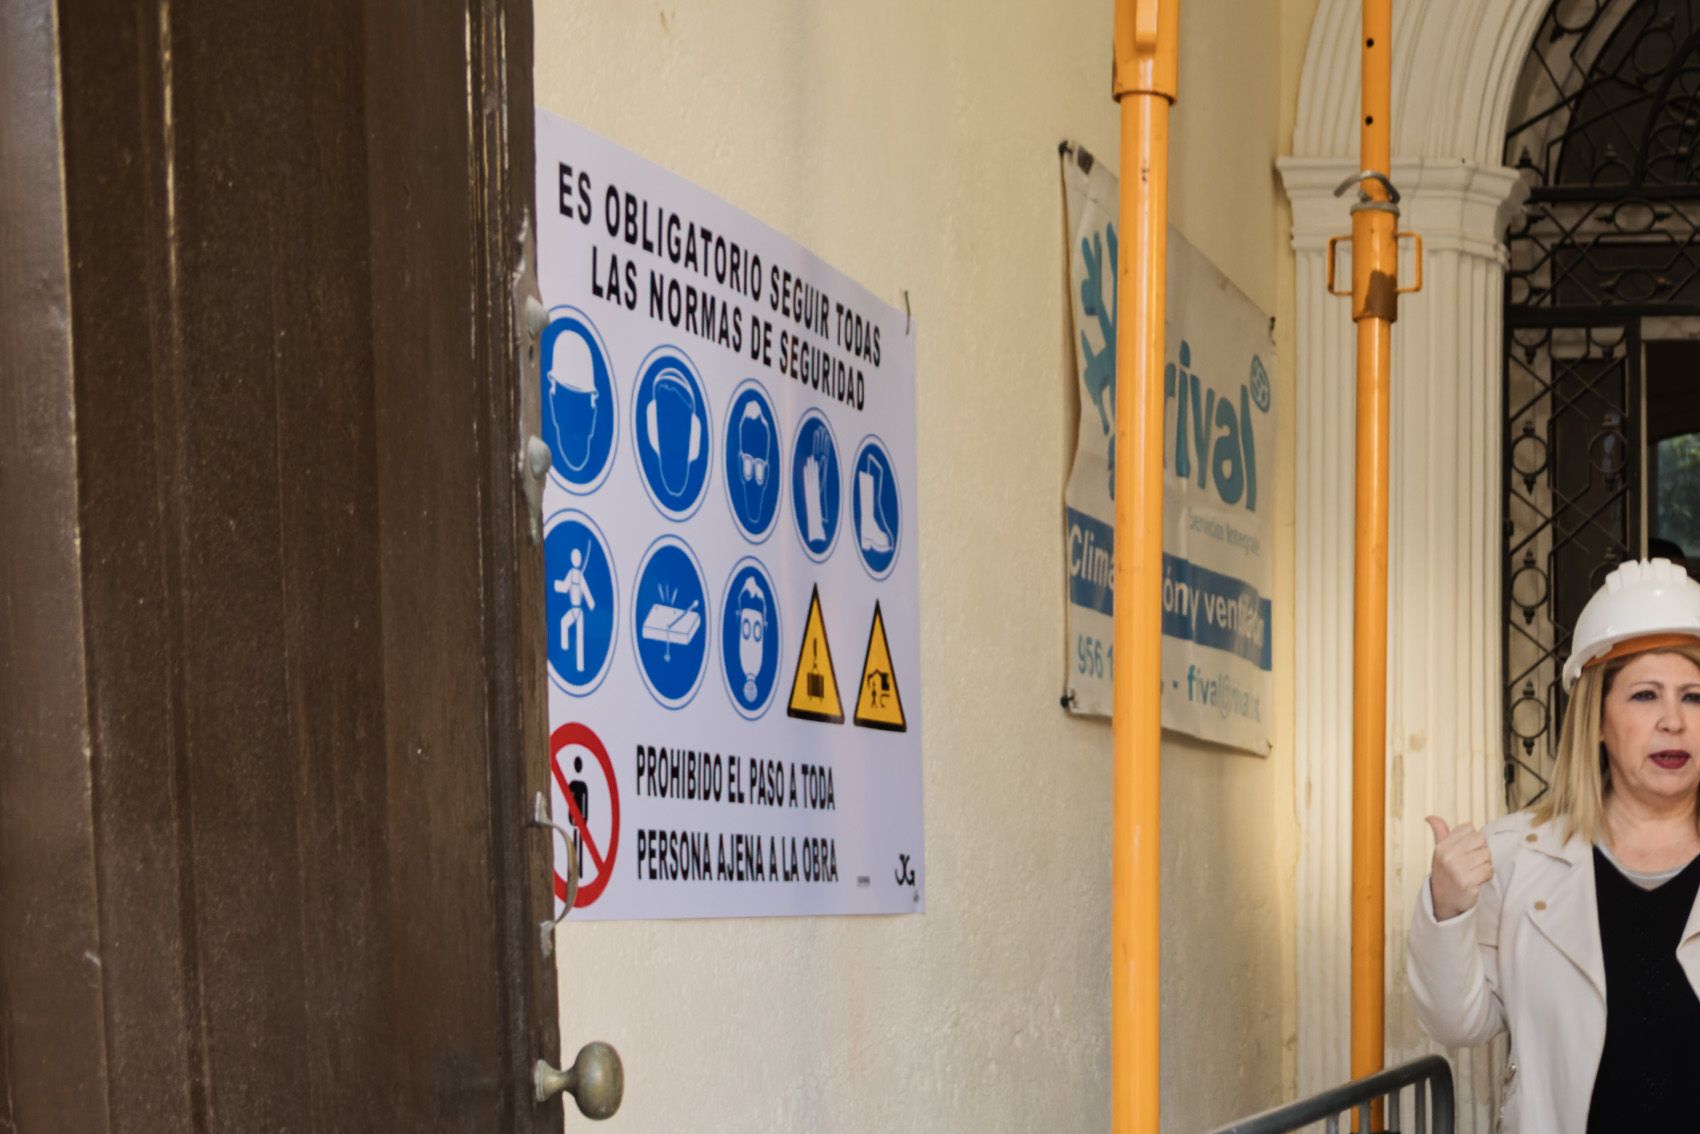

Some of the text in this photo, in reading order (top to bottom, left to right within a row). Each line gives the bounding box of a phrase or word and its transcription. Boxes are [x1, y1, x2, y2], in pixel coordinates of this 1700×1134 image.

[558, 162, 881, 368] ES OBLIGATORIO SEGUIR TODAS
[592, 245, 865, 412] LAS NORMAS DE SEGURIDAD
[1078, 634, 1104, 680] 956
[636, 744, 836, 810] PROHIBIDO EL PASO A TODA
[637, 829, 839, 882] PERSONA AJENA A LA OBRA
